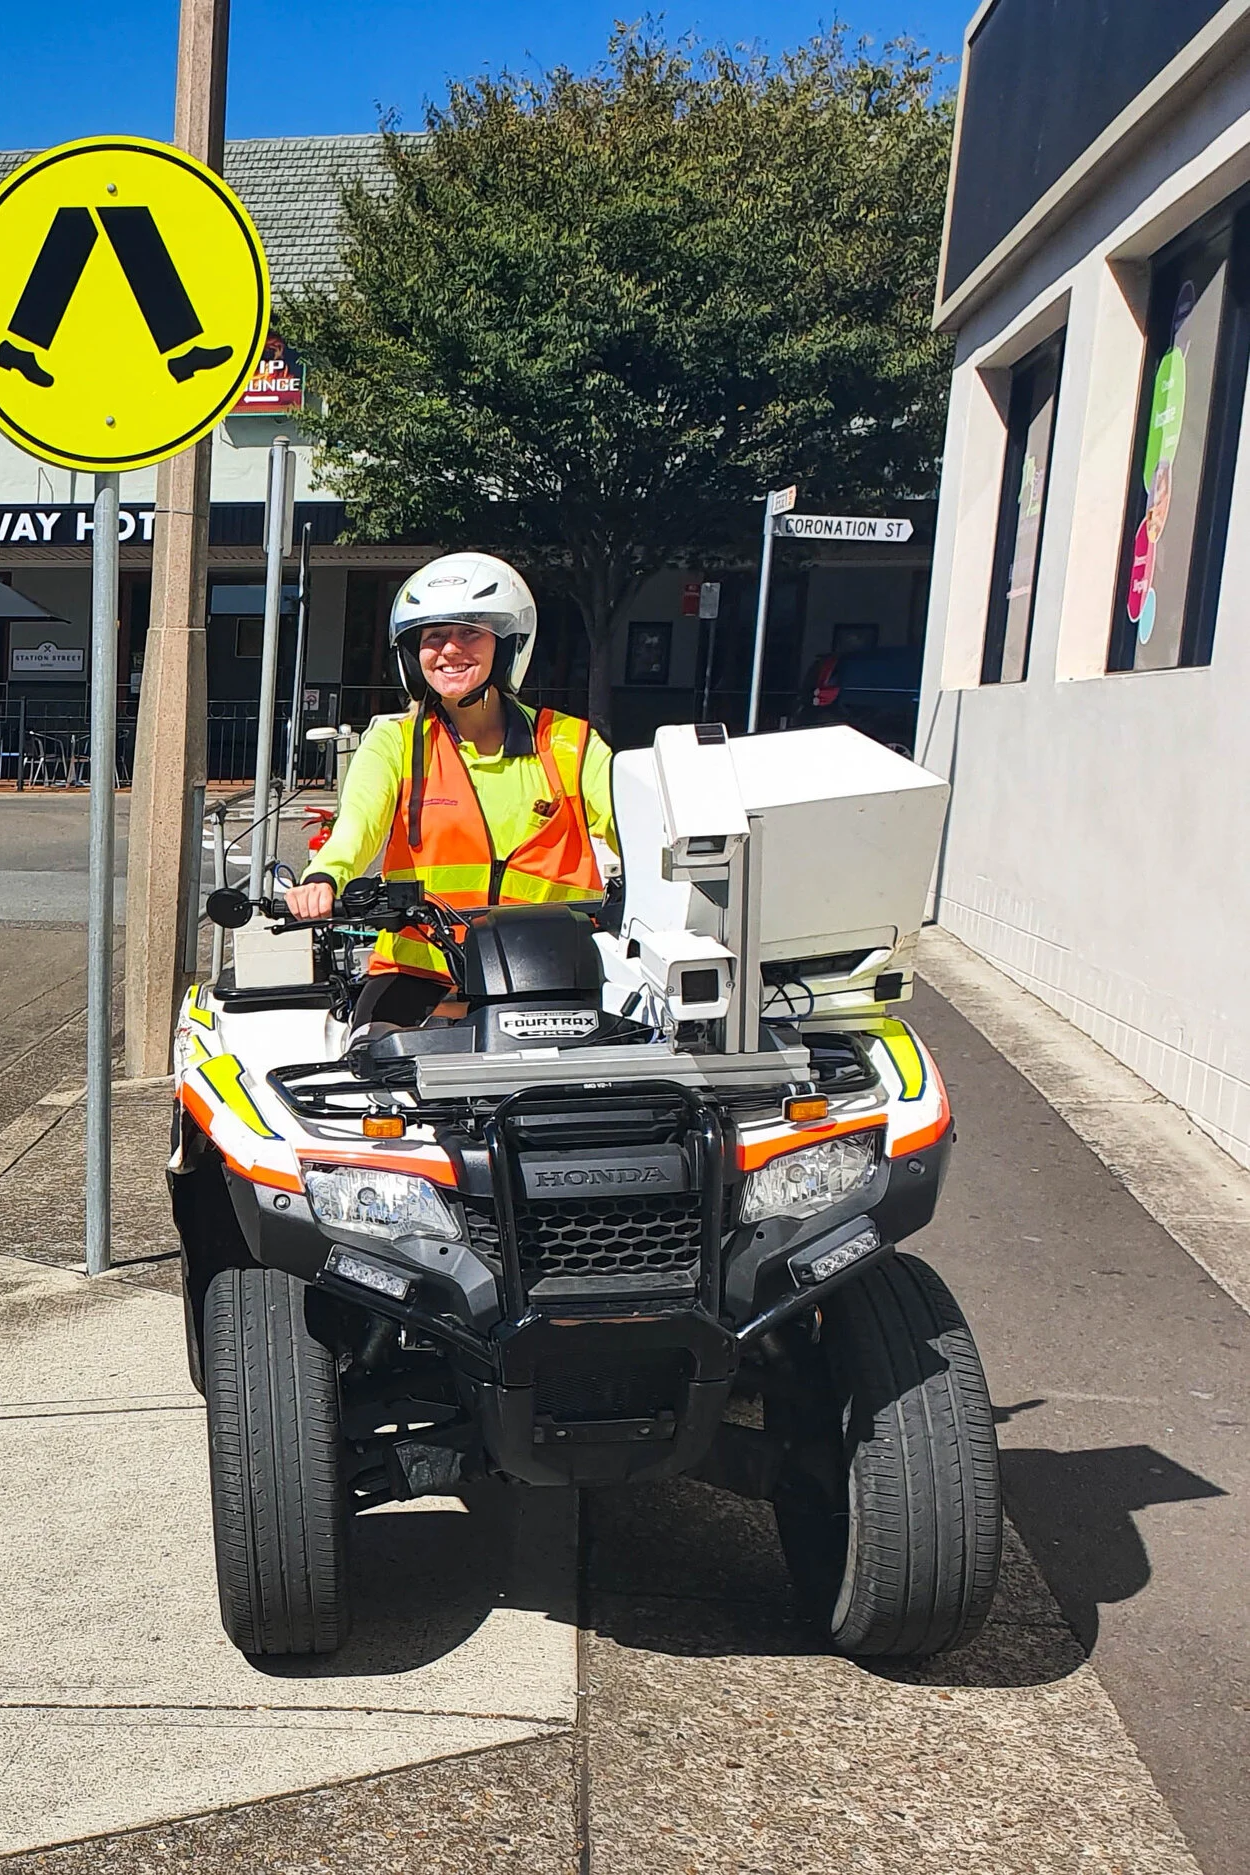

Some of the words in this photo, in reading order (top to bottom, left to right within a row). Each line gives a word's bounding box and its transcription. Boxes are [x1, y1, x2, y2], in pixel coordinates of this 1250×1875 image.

[244, 378, 301, 392] UNGE
[76, 511, 155, 542] HOT
[785, 518, 877, 538] CORONATION
[885, 522, 904, 538] ST
[15, 654, 49, 662] STATION
[52, 654, 81, 662] STREET
[504, 1017, 595, 1028] FOURTRAX
[535, 1166, 670, 1188] HONDA
